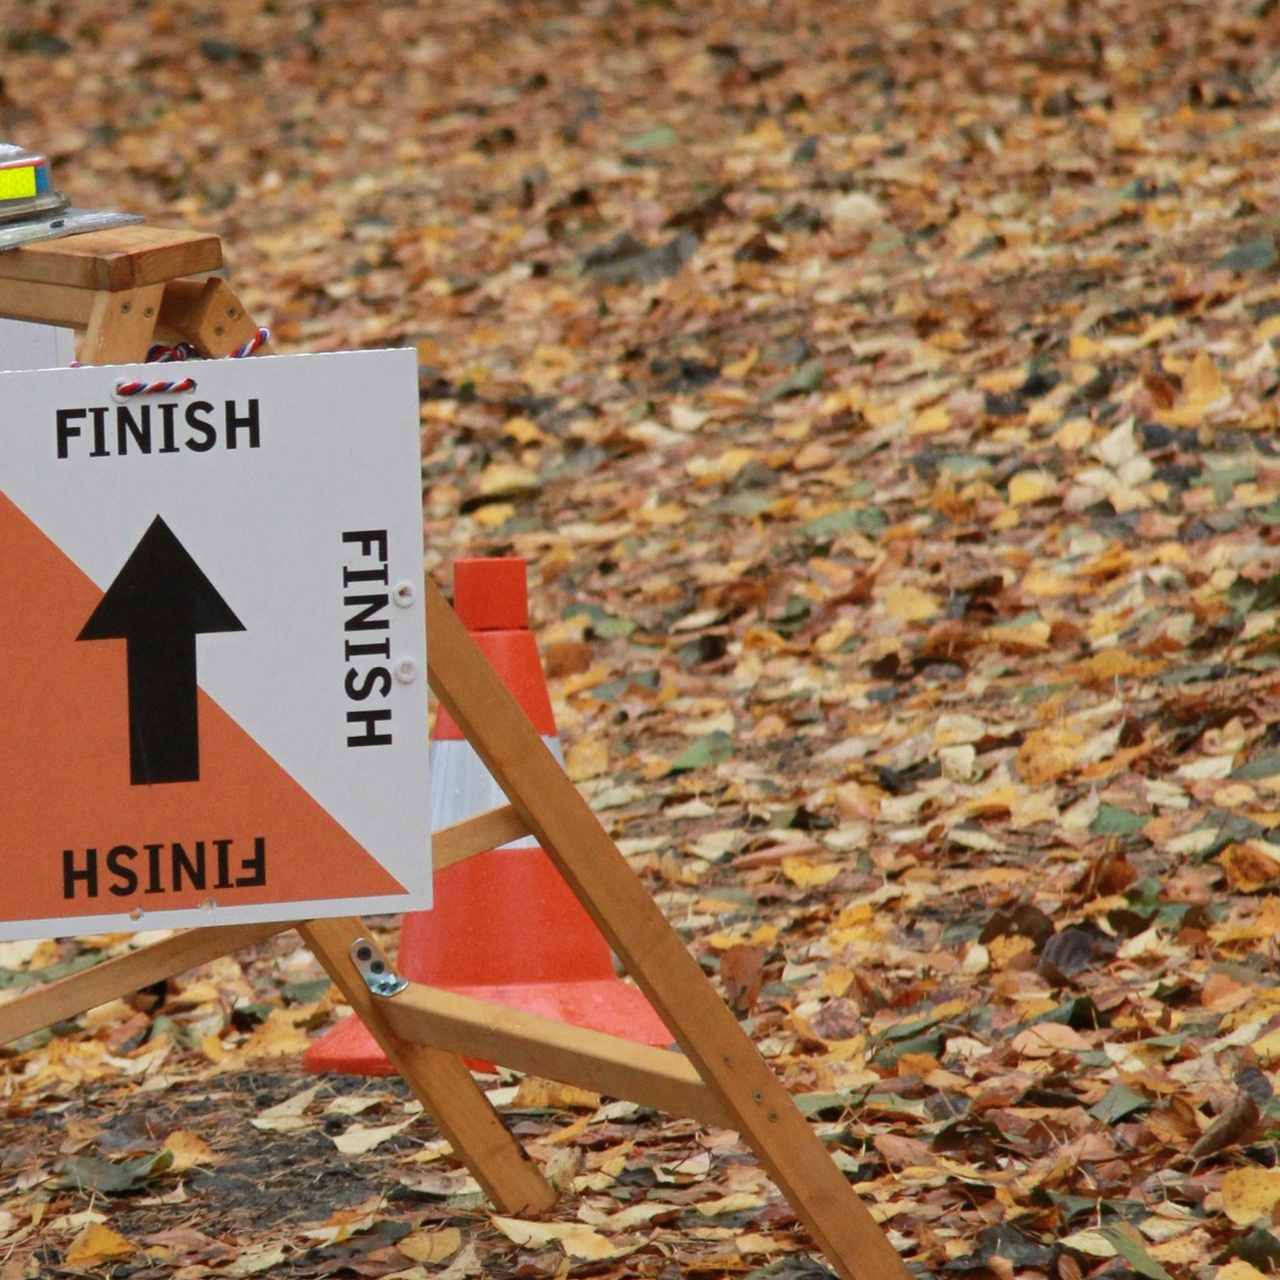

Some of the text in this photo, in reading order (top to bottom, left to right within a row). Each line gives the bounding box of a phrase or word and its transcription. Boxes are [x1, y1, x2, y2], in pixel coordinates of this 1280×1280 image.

[57, 399, 259, 458] FINISH
[343, 530, 392, 747] FINISH
[63, 838, 265, 899] FINISH
